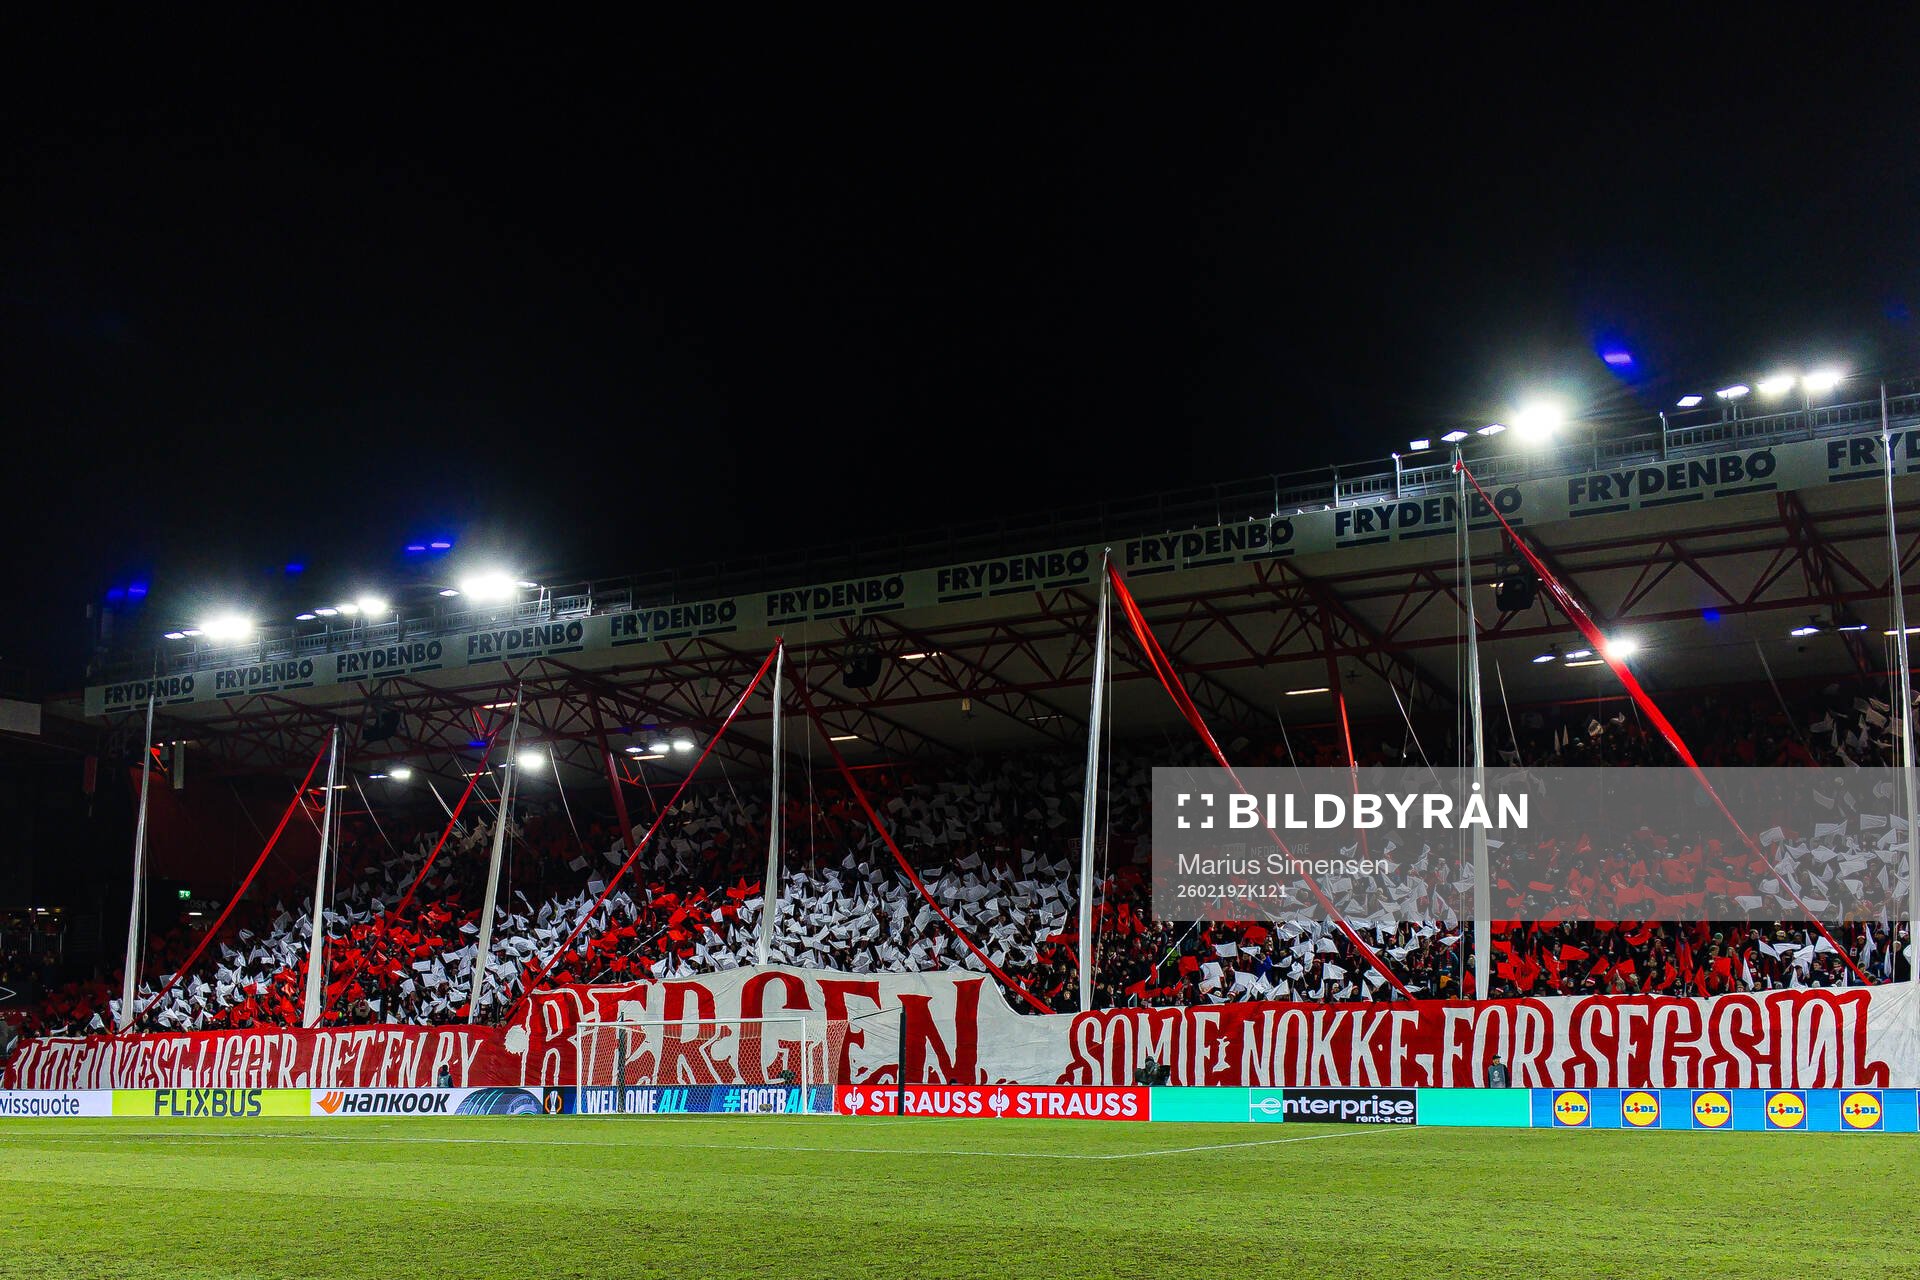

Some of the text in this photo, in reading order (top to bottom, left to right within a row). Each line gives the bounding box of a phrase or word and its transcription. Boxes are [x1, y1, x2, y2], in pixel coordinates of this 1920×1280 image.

[1569, 448, 1777, 505] FRYDENBØ
[1336, 485, 1523, 537] FRYDENBØ
[1126, 518, 1294, 565] FRYDENBØ
[937, 547, 1089, 592] FRYDENBØ
[767, 577, 904, 616] FRYDENBØ
[611, 600, 737, 637] FRYDENBØ
[467, 621, 583, 655] FRYDENBØ
[215, 657, 314, 689] FRYDENBØ
[336, 638, 442, 674] FRYDENBØ
[104, 674, 194, 705] FRYDENBØ
[114, 1037, 191, 1089] VEST
[195, 1034, 298, 1088] LIGGER
[310, 1030, 376, 1088] DET
[520, 971, 986, 1085] BERGEN
[1242, 1009, 1433, 1087] NOKKE
[1442, 1004, 1549, 1087] FOR
[1563, 1004, 1692, 1087] SEG
[586, 1089, 689, 1113] WELOME ALL
[870, 1090, 983, 1114] STRAUSS
[1016, 1092, 1138, 1116] STRAUSS
[1258, 1095, 1414, 1120] enterprise
[1355, 1115, 1414, 1123] rent-a-car
